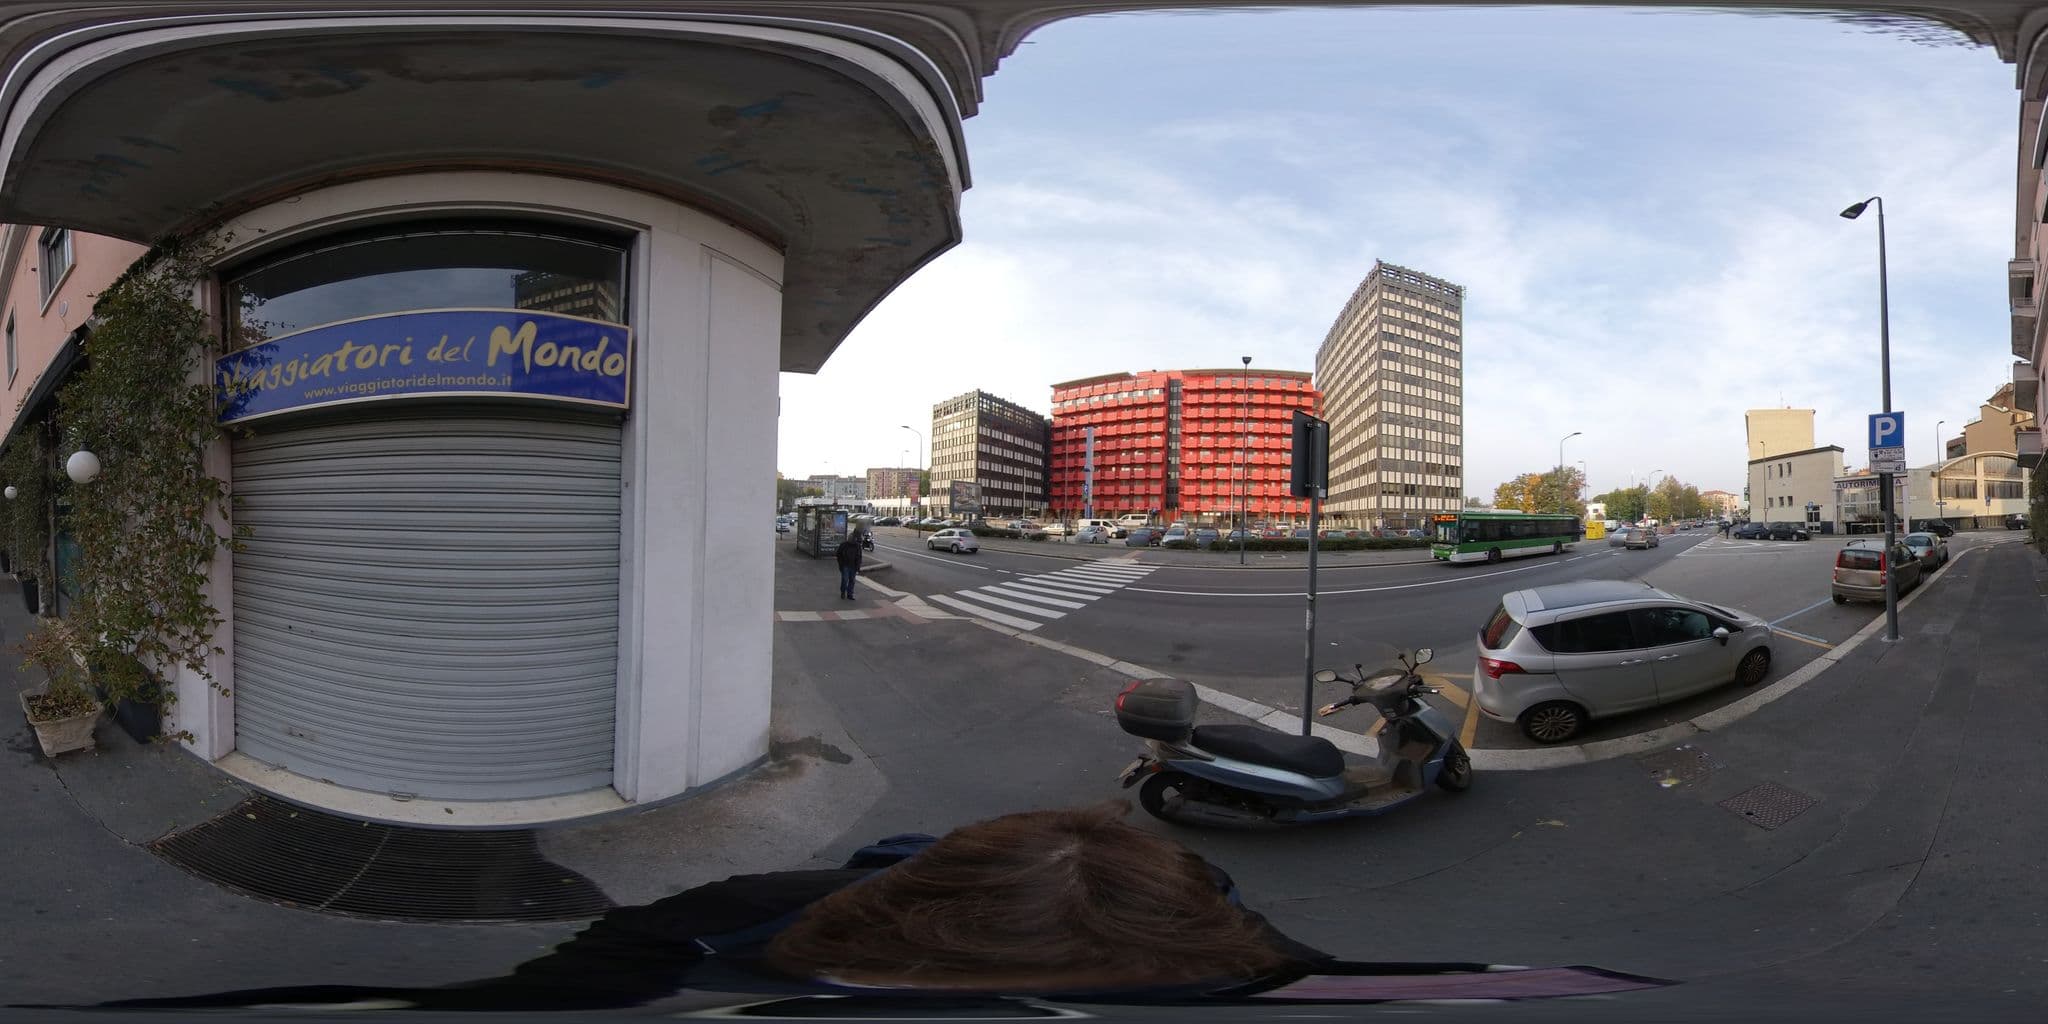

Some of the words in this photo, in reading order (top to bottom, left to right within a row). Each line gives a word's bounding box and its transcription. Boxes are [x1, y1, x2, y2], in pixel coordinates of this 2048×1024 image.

[223, 337, 413, 397] Viaggiatori
[427, 334, 476, 364] del
[487, 321, 625, 377] Mondo
[303, 374, 512, 399] www.viaggiatoridelmondo.it
[1875, 416, 1897, 446] P
[1836, 478, 1901, 489] AUTORIMA
